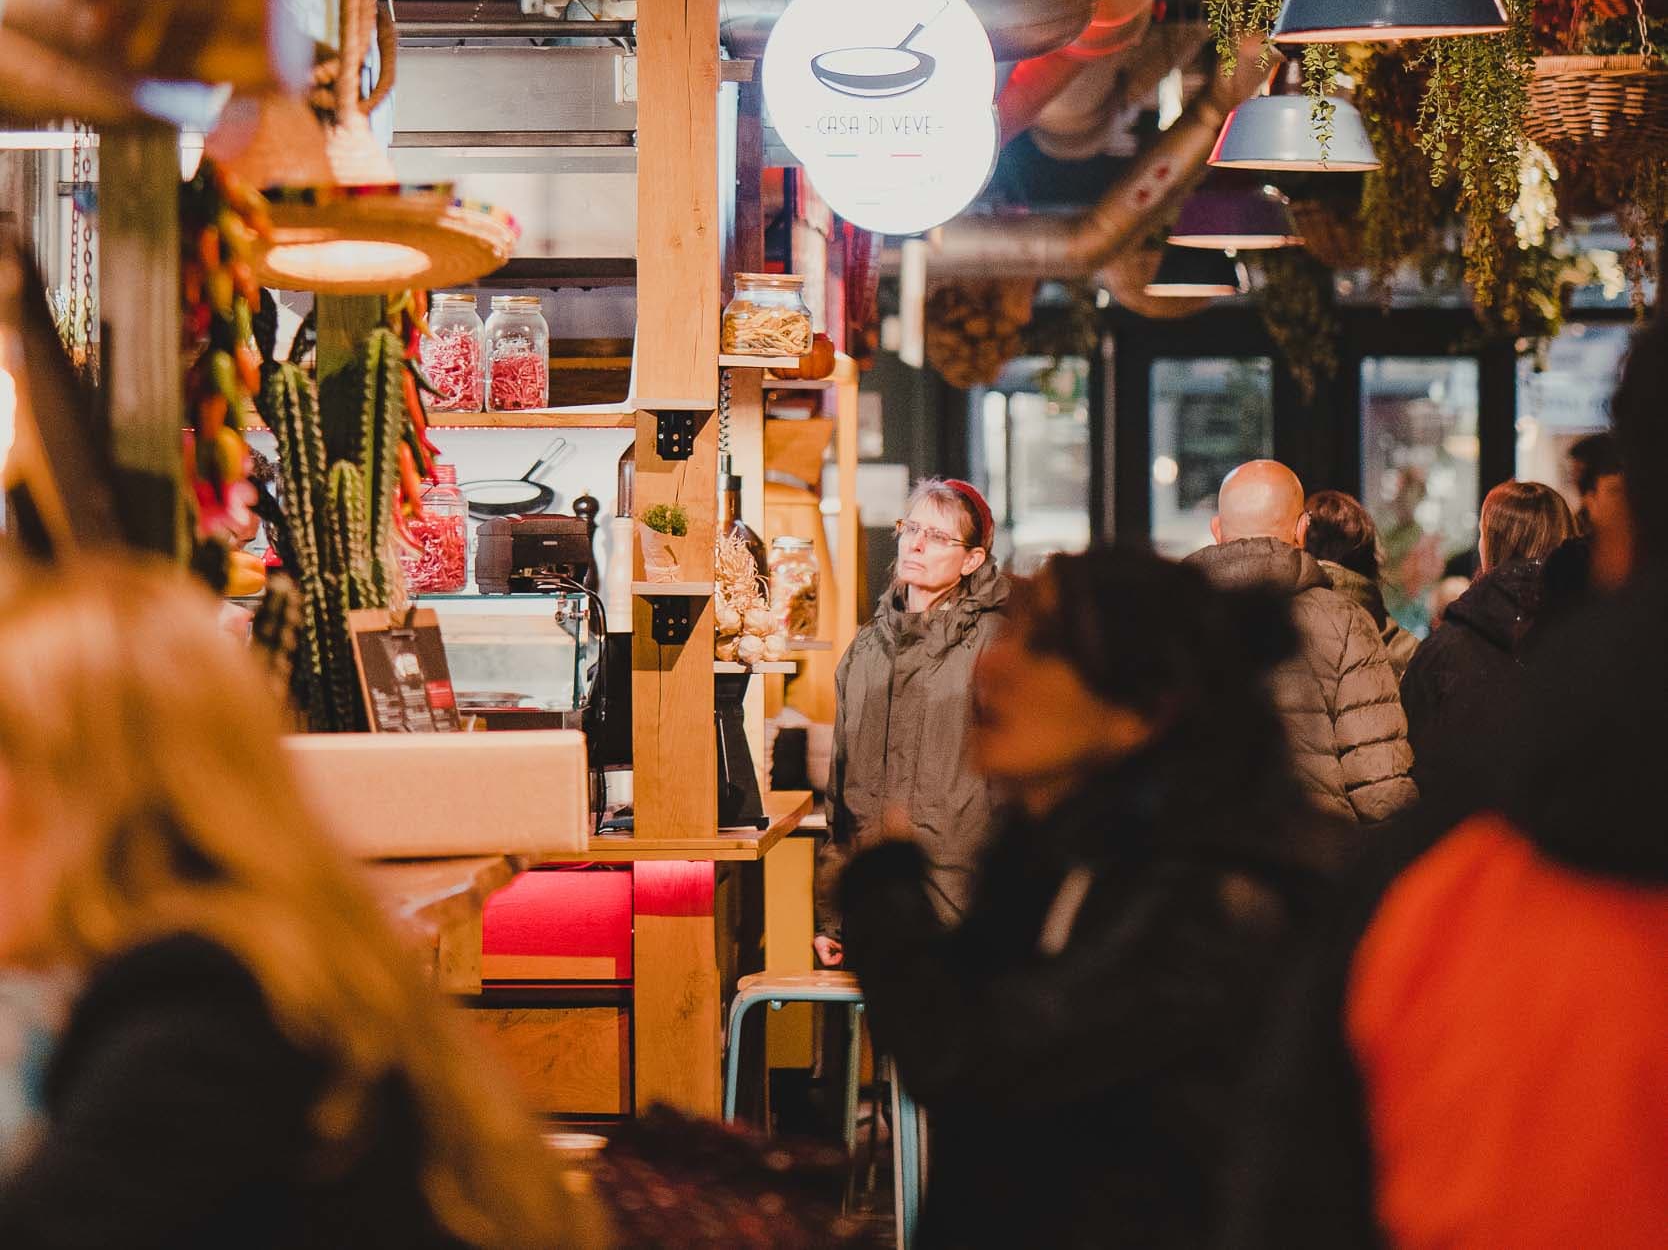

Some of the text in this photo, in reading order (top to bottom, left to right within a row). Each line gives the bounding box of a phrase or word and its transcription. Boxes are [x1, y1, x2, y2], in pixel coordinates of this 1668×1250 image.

[817, 116, 931, 135] CASA DI VEVE
